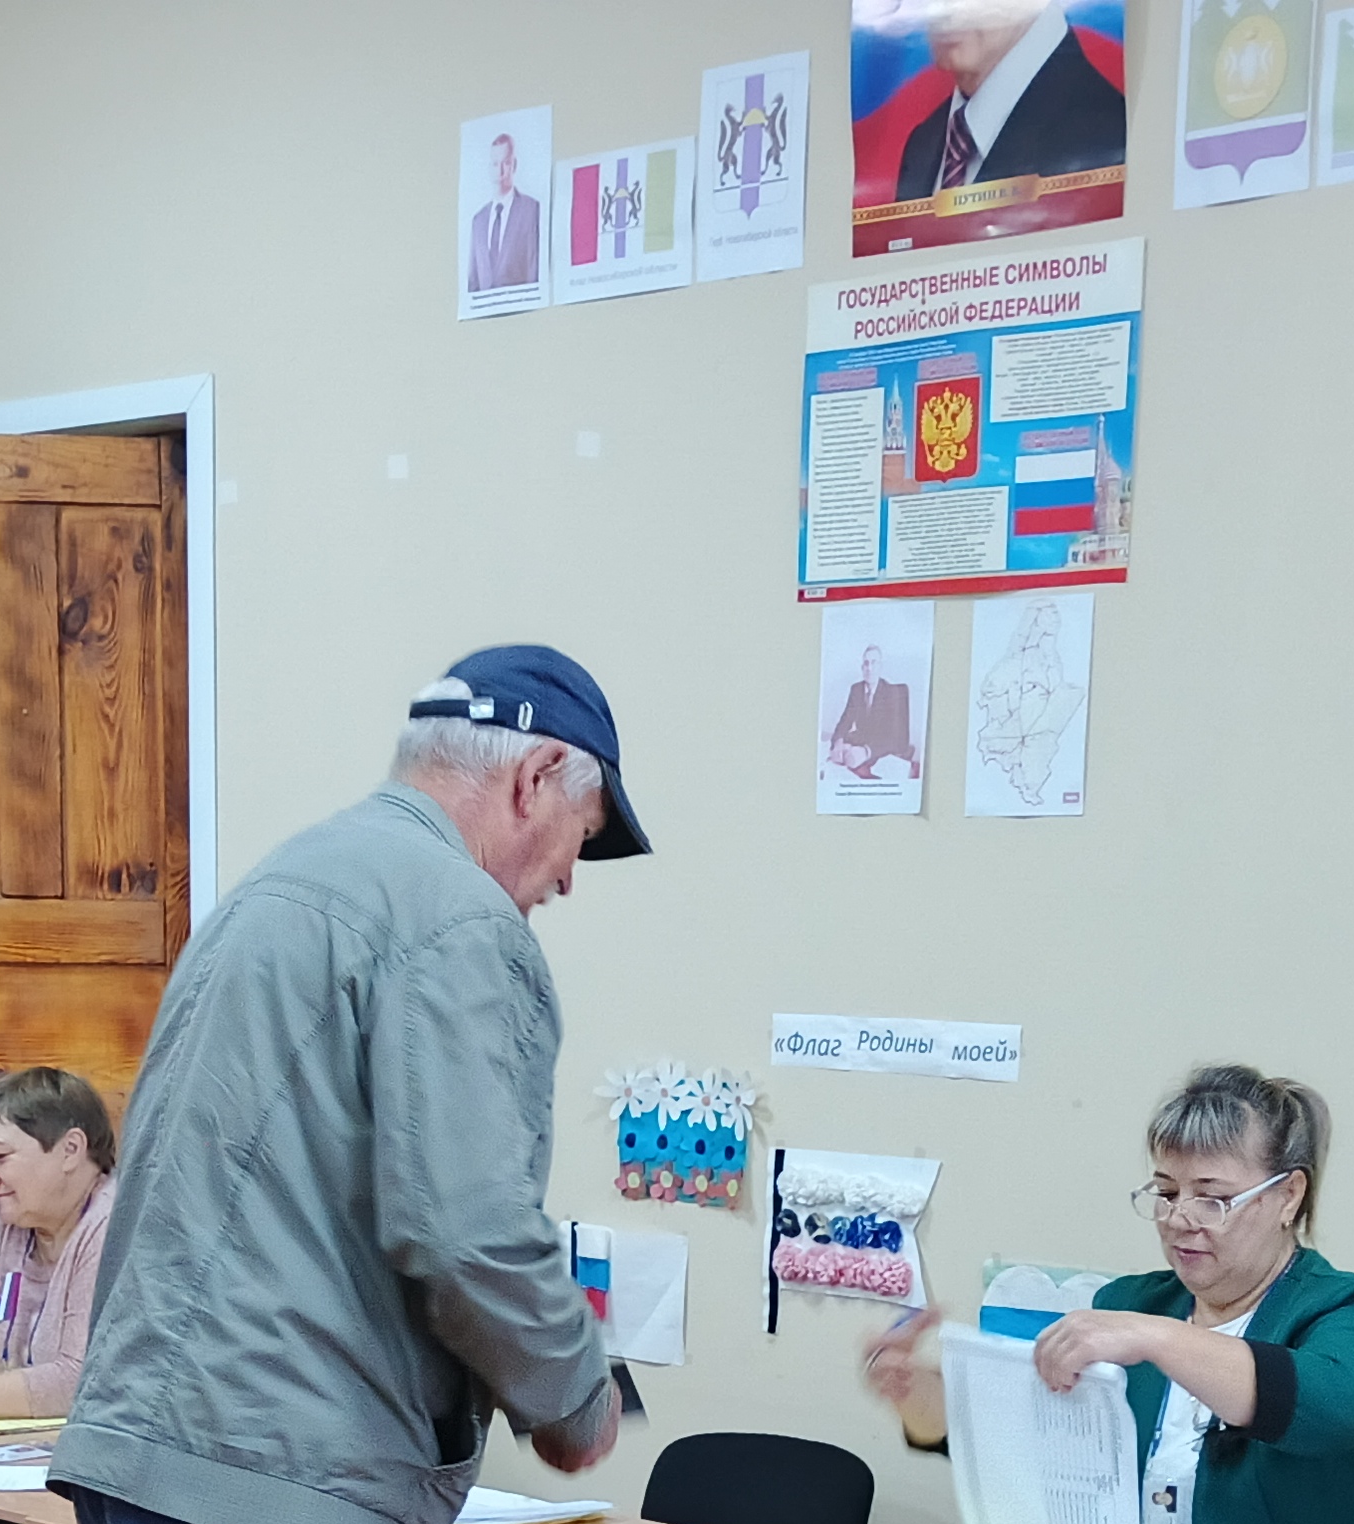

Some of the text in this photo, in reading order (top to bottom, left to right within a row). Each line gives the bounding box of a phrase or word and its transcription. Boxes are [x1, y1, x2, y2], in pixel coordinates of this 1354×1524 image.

[837, 253, 1108, 310] ГОСУДАРСТВЕННЫЕ СИМВОЛЫ
[853, 291, 1081, 340] РОССИЙСКОЙ ФЕДЕРАЦИИ
[774, 1029, 1018, 1062] «Флаг Родины моей»
